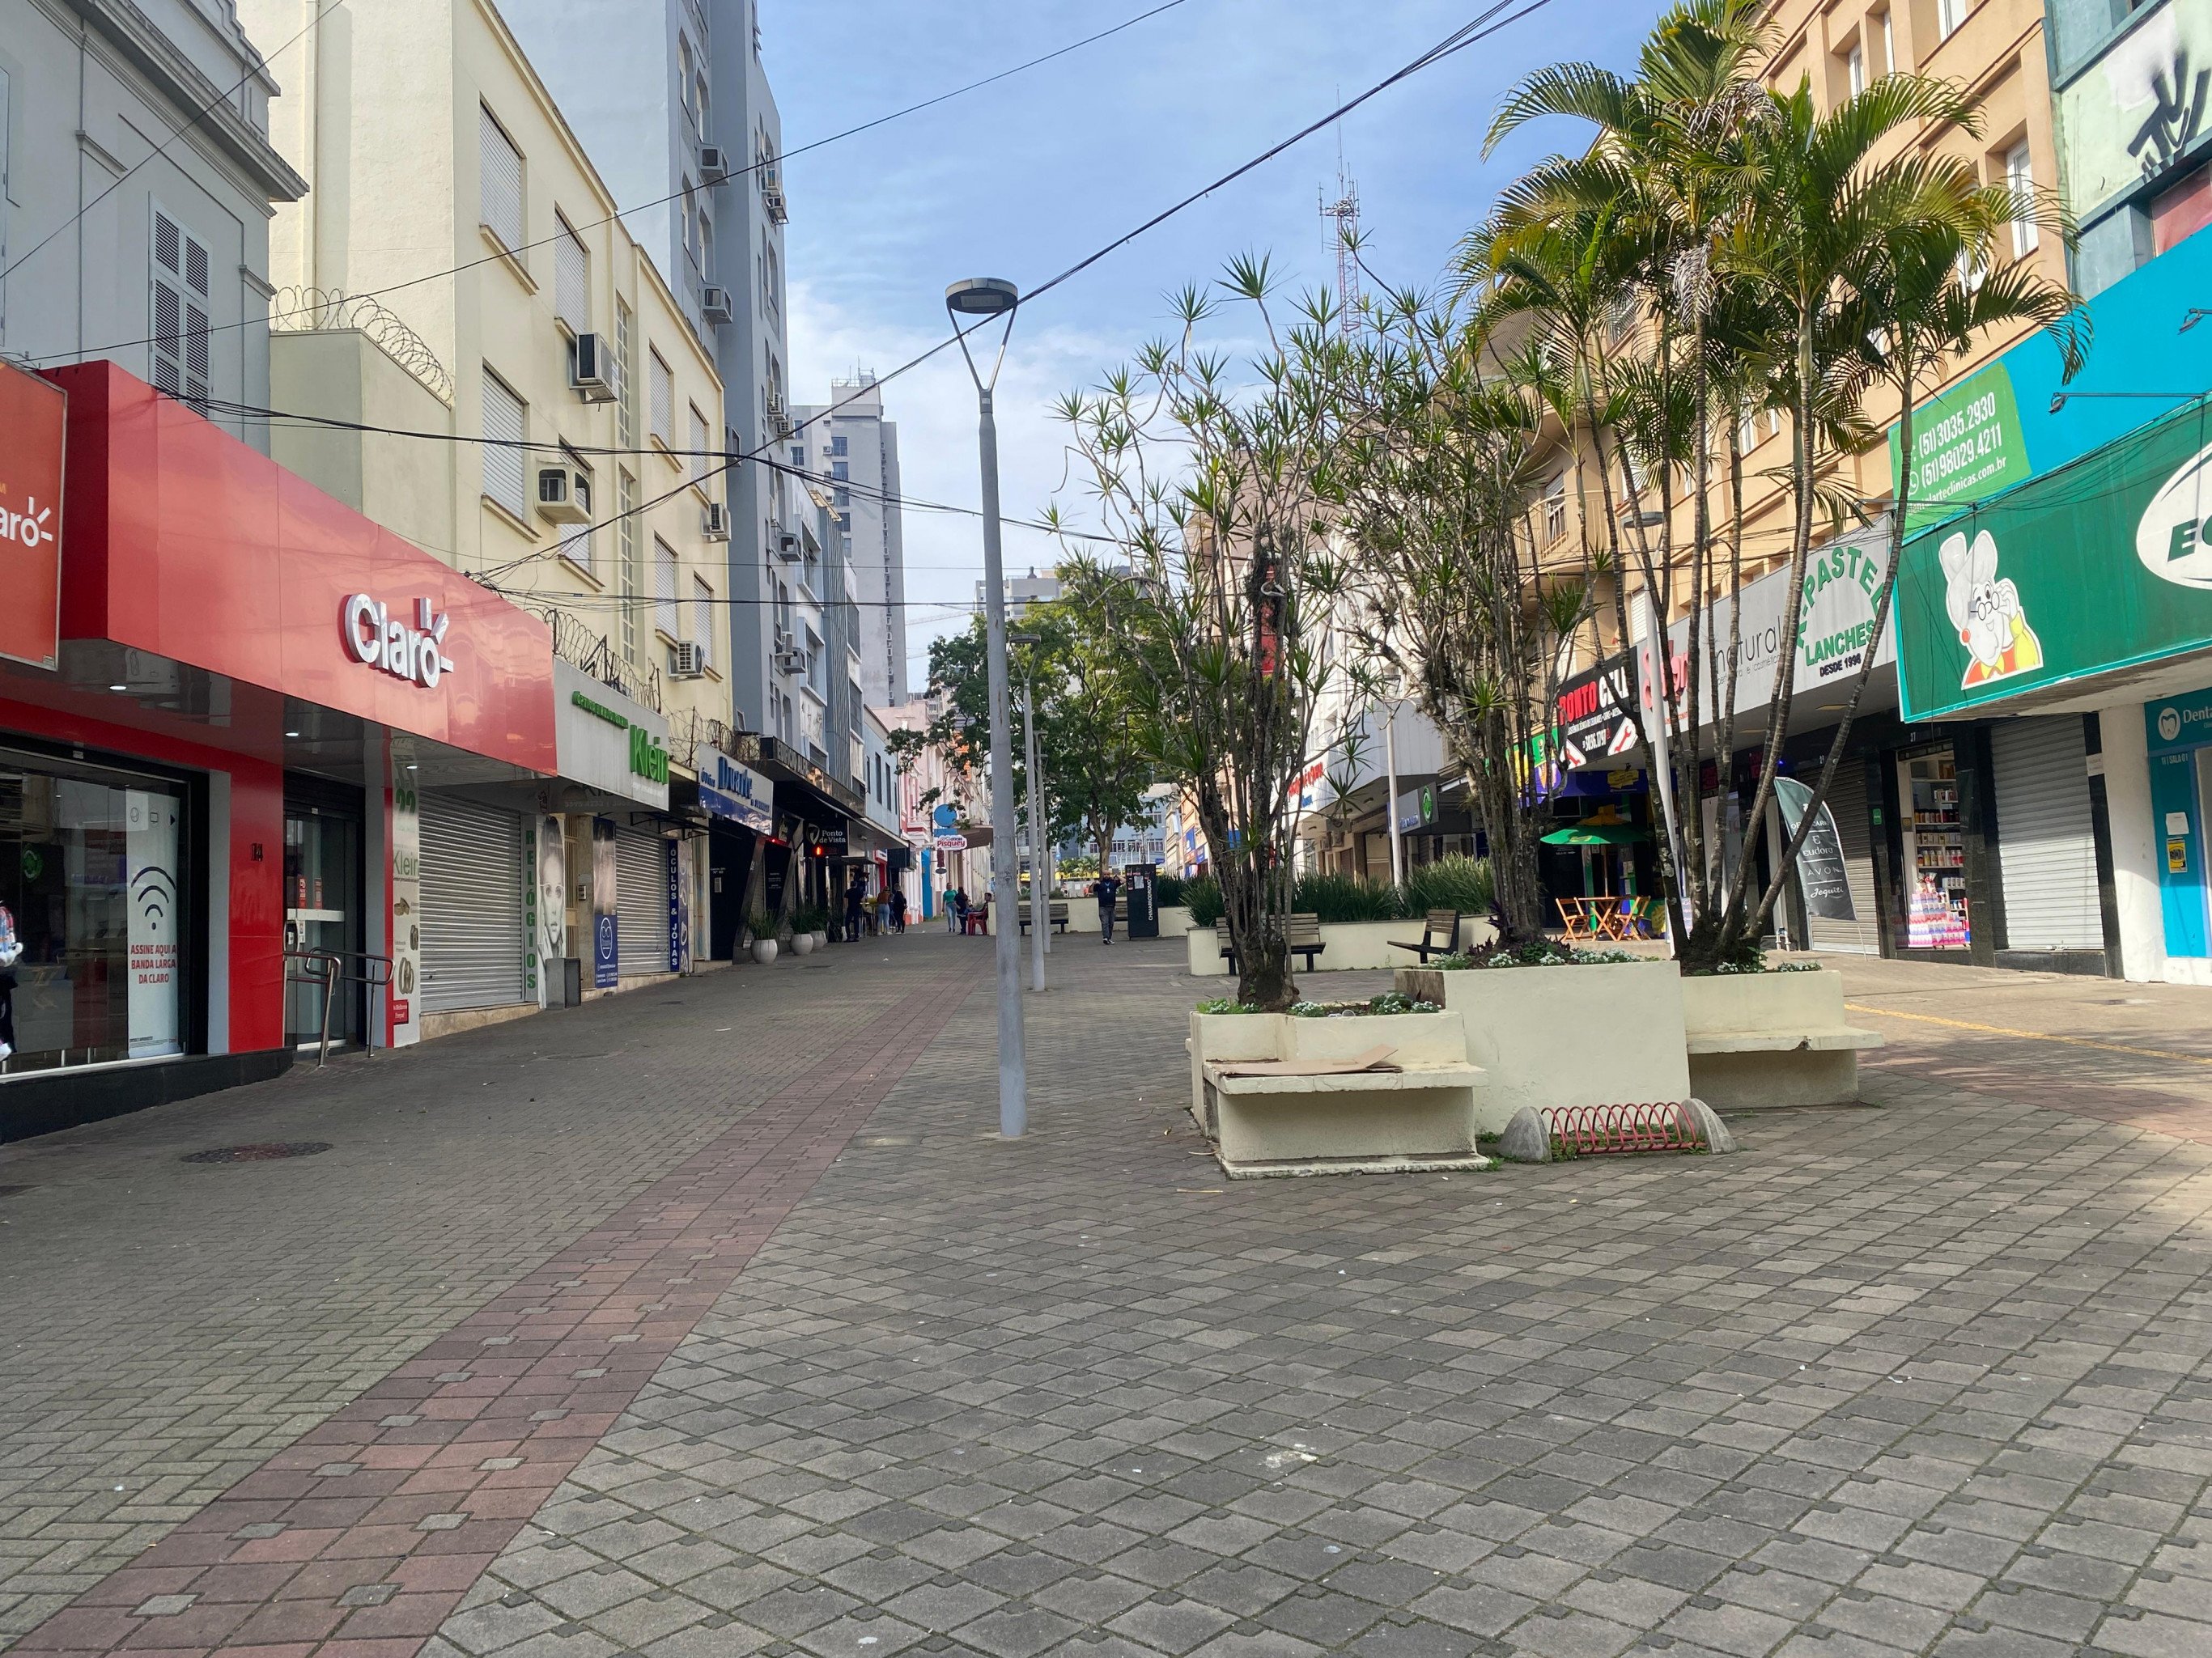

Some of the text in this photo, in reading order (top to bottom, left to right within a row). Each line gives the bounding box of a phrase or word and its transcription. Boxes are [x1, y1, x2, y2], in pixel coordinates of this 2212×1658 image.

[1919, 392, 1996, 458] (51) 3035.2930
[1921, 422, 2002, 489] (51) 98029.4211
[346, 592, 445, 689] Claro
[1805, 619, 1876, 667] LANCHES
[1819, 653, 1862, 677] DESDE 1998
[1558, 681, 1598, 726] PONTO
[2182, 706, 2212, 723] Dent
[630, 724, 669, 786] Klein
[1802, 846, 1833, 857] eudora
[1807, 866, 1840, 877] AVON
[1811, 886, 1844, 898] Jequiti
[526, 829, 537, 989] RELÓGIOS
[131, 944, 176, 956] ASSINE AQUI A
[131, 959, 176, 969] BANDA LARGA
[138, 973, 169, 984] DA CLARO
